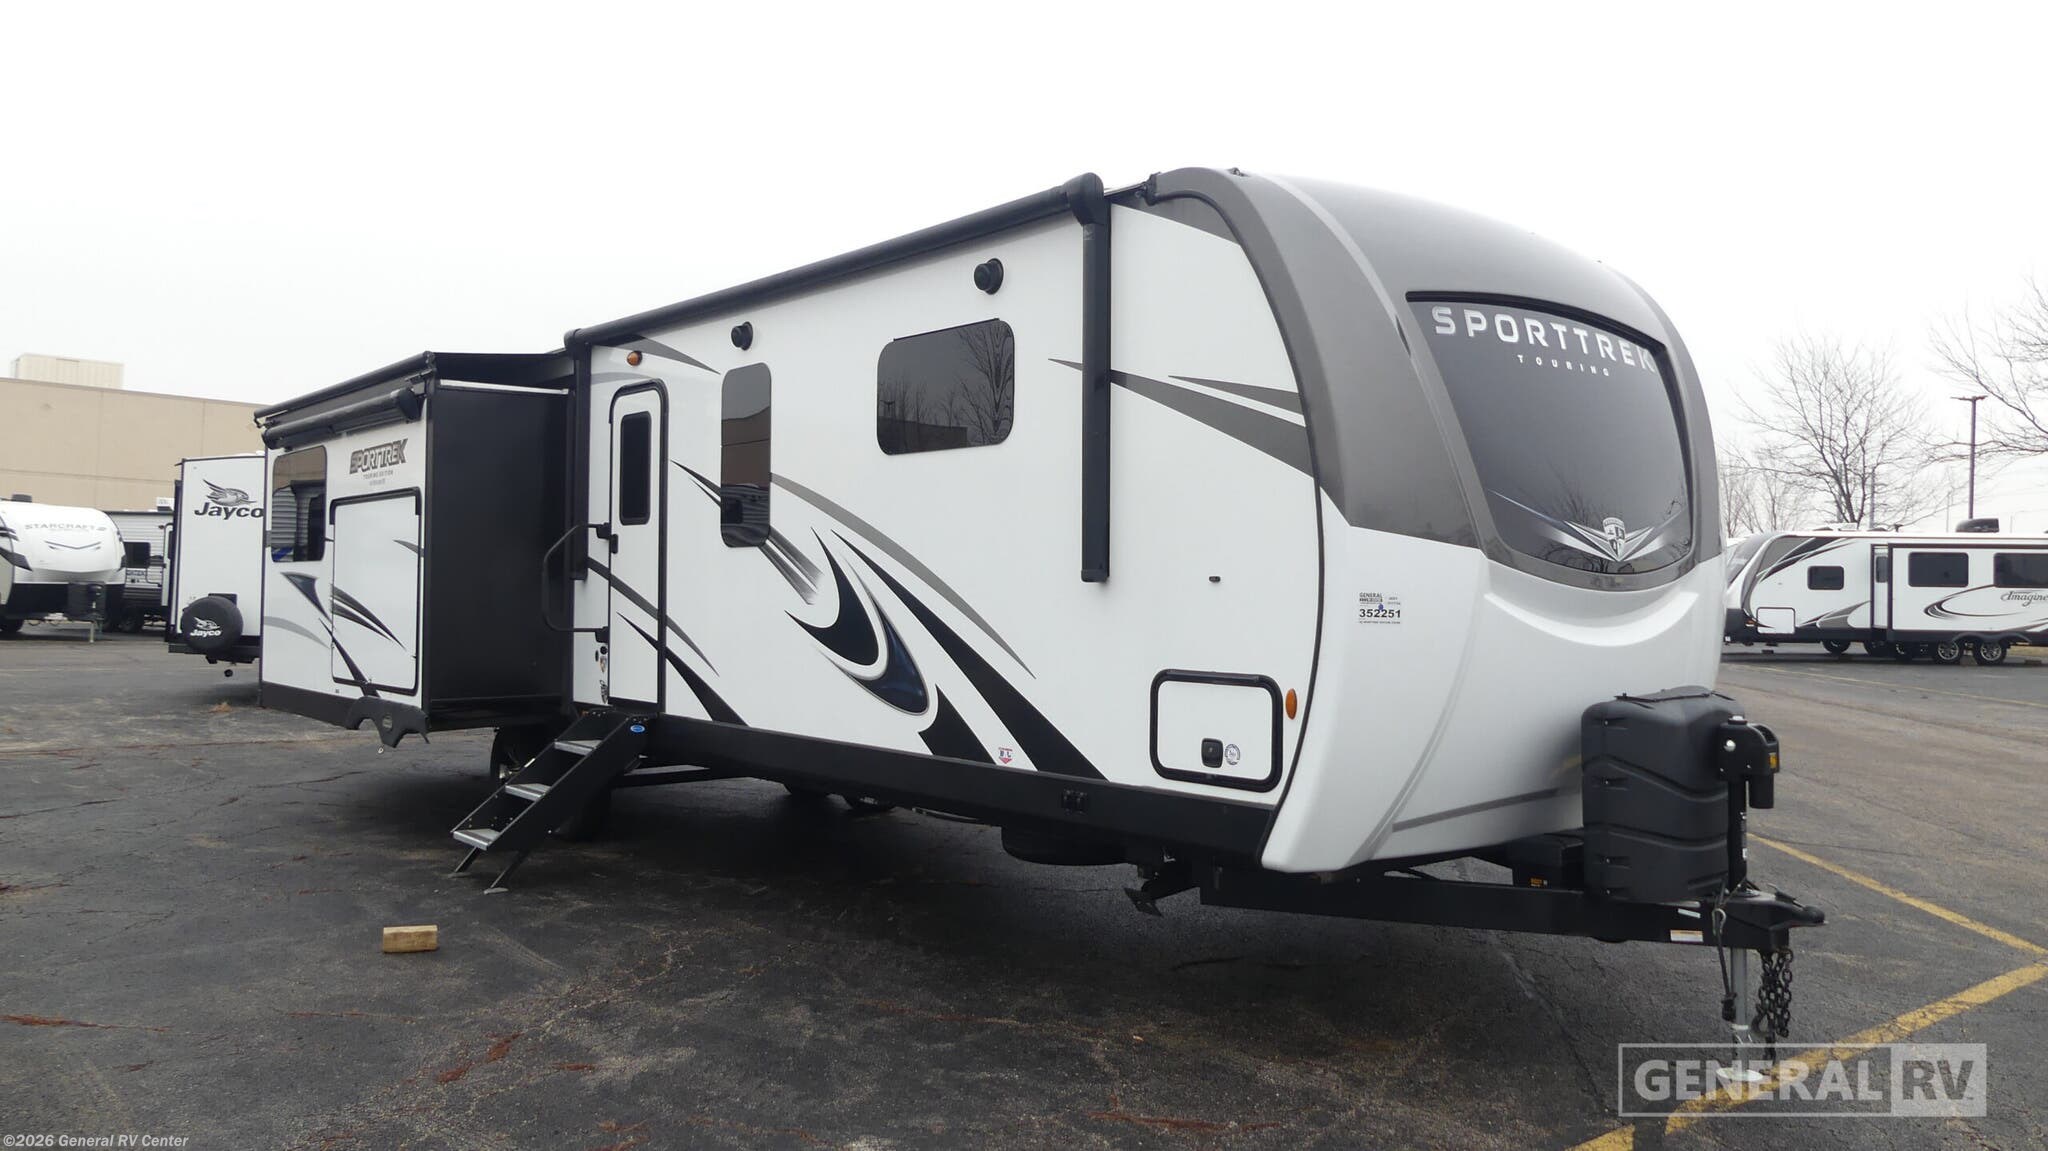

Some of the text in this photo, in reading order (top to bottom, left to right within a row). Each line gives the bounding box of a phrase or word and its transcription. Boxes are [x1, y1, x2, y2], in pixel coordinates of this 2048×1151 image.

[1431, 306, 1657, 374] SPORTTREK
[1517, 354, 1610, 377] TOURING
[194, 501, 265, 521] Jayco
[1359, 608, 1401, 619] 352251
[190, 629, 222, 638] Jayco
